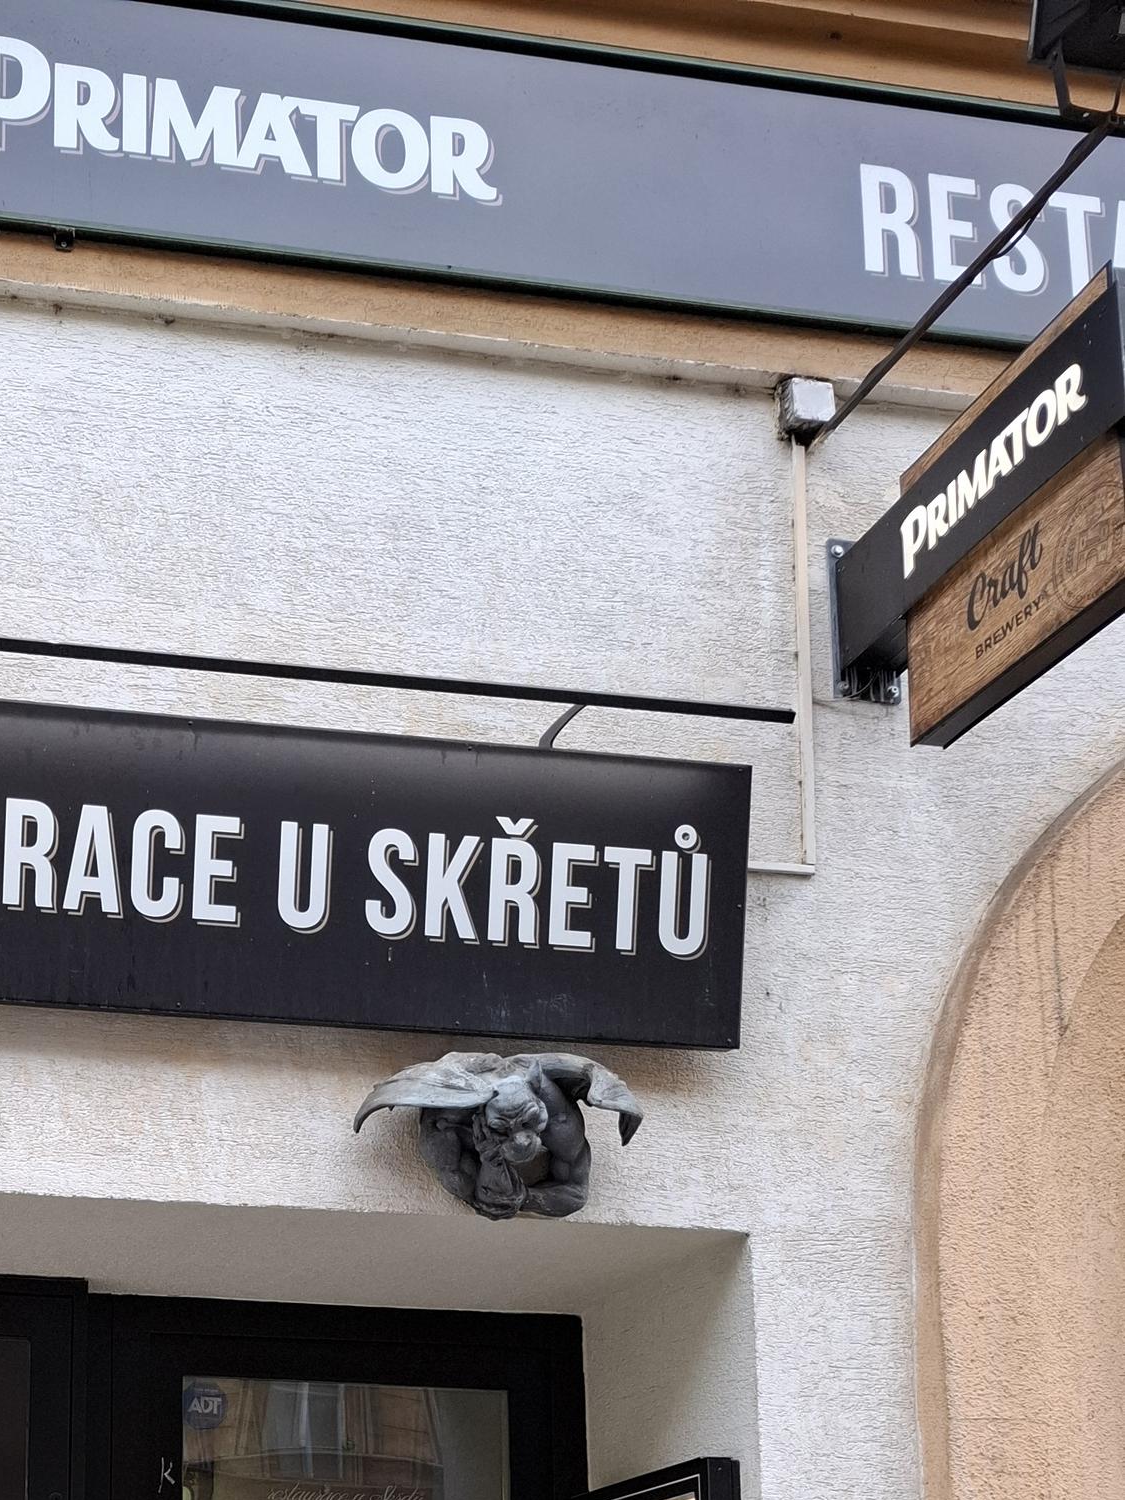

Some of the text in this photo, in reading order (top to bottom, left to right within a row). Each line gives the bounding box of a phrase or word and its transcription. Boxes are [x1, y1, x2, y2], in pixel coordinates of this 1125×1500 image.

[967, 519, 1043, 631] Craft
[975, 594, 1045, 659] BREWERY
[278, 820, 333, 934] U
[365, 816, 712, 960] SKŘETŮ
[187, 1396, 223, 1415] ADT
